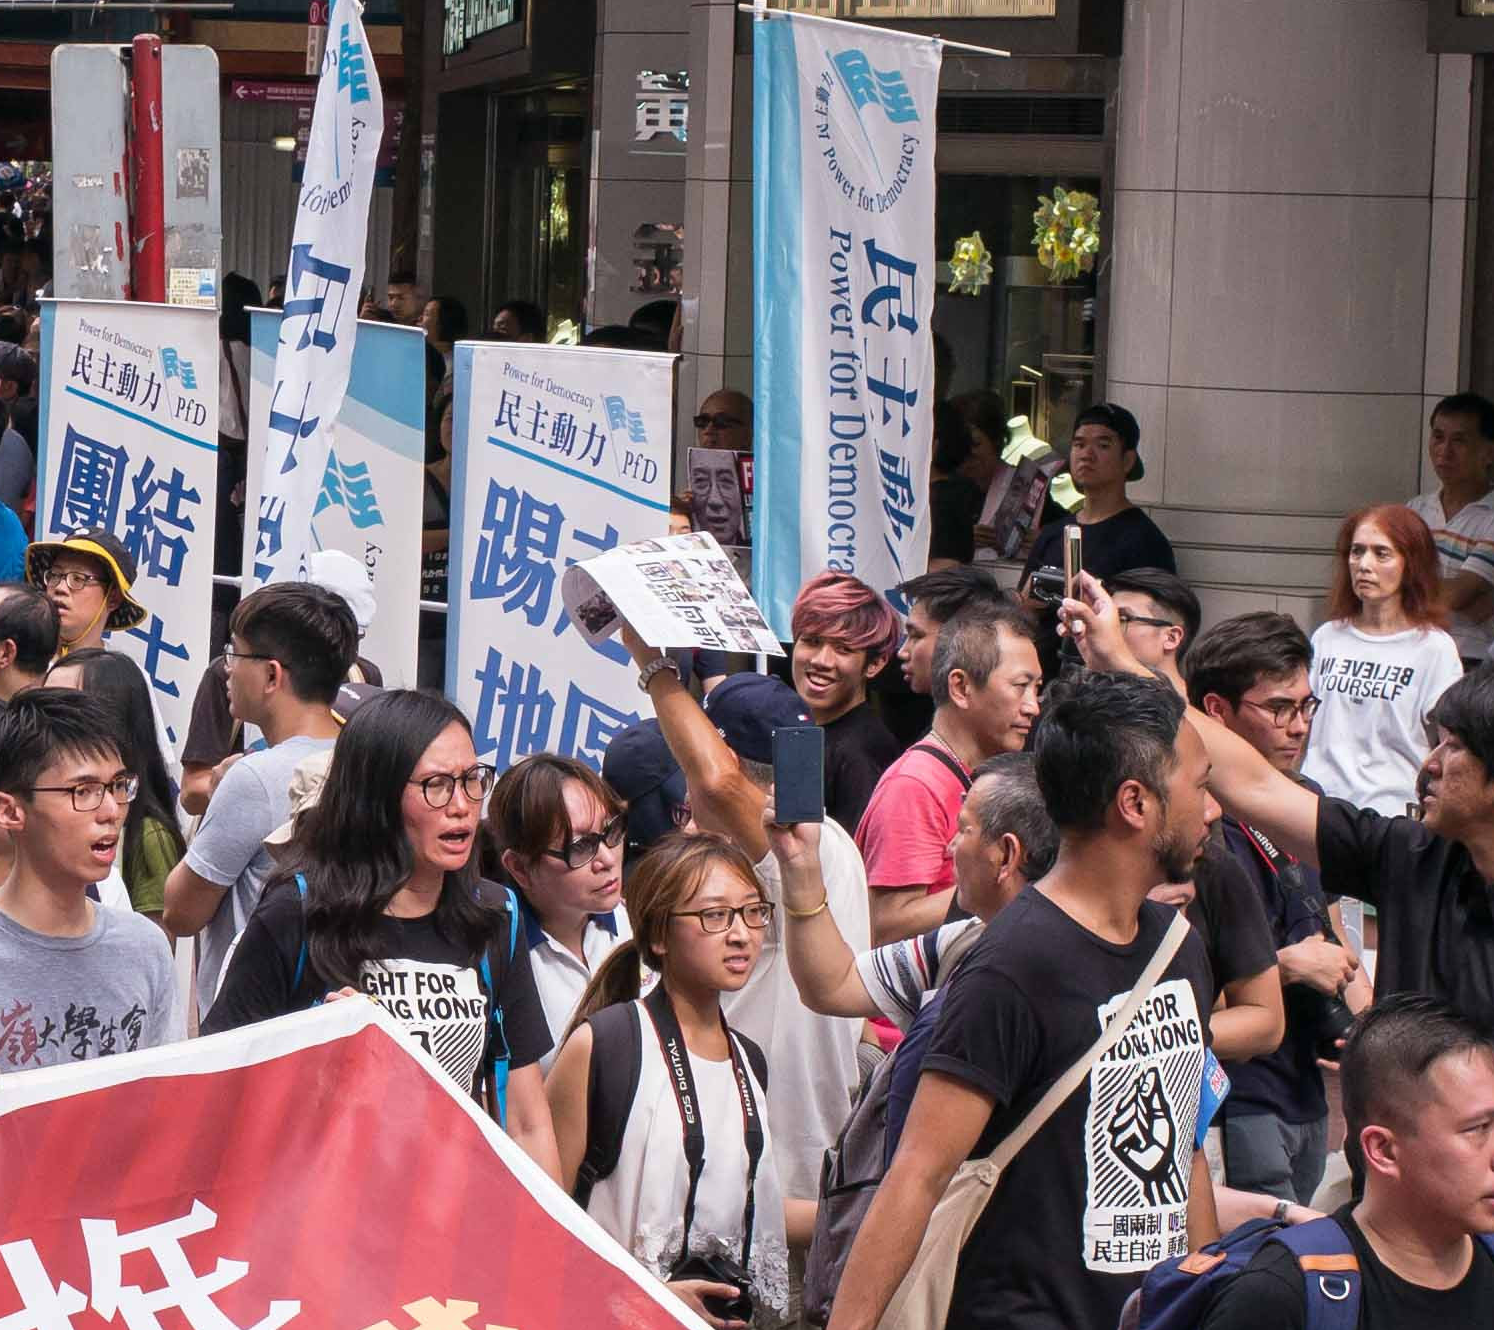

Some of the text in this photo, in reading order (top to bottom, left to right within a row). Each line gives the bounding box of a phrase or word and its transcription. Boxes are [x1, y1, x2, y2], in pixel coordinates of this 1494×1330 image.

[823, 133, 921, 215] Power for Democracy
[78, 318, 154, 364] Power for Democracy
[71, 342, 163, 412] 民主動力
[503, 362, 595, 412] Power for Democracy
[175, 396, 207, 427] PfD
[826, 227, 867, 575] Power for Democra
[495, 389, 607, 468] 民主動力
[622, 449, 659, 486] PfD
[49, 423, 202, 589] 團結
[1321, 675, 1403, 702] YOURSELF
[1249, 826, 1279, 860] Canon
[363, 972, 457, 997] GHT FOR
[417, 998, 484, 1021] KONG
[1152, 1019, 1200, 1051] KONG
[666, 1037, 696, 1125] EOS DIGITAL
[1094, 1214, 1162, 1239] 一國兩制
[1093, 1239, 1161, 1263] 民主自治
